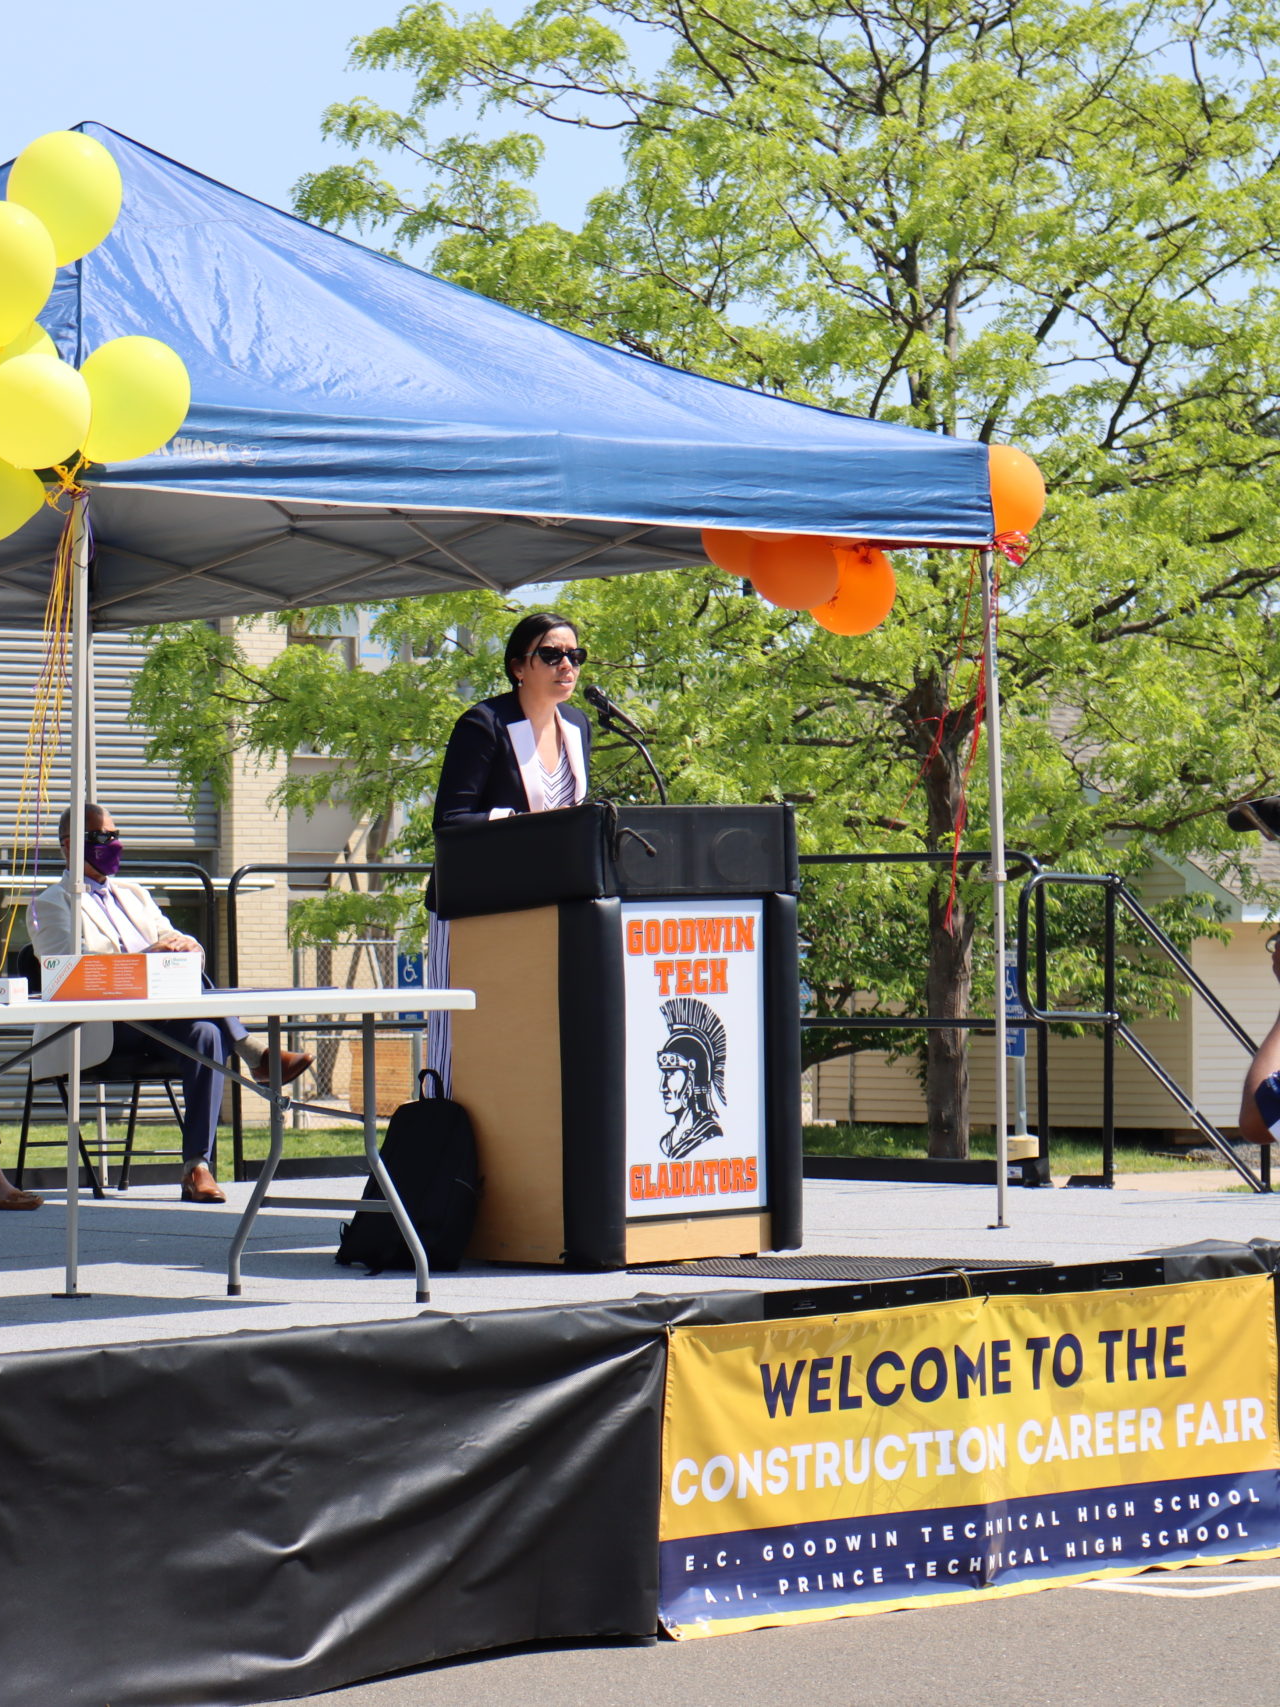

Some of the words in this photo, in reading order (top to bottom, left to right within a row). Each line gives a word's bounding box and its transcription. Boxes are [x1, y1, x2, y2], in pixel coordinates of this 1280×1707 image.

[626, 915, 756, 956] GOODWIN
[654, 958, 729, 996] TECH
[629, 1156, 758, 1201] GLADIATORS
[759, 1339, 1012, 1419] WELCOME
[1025, 1333, 1083, 1390] TO
[1098, 1325, 1187, 1384] THE
[670, 1421, 1008, 1507] CONSTRUCTION
[1016, 1406, 1166, 1466] CAREER
[1175, 1396, 1268, 1449] FAIR
[685, 1550, 741, 1572] E.C.
[762, 1530, 898, 1562] GOODWIN
[921, 1510, 1060, 1543] TECHNICAL
[1077, 1501, 1135, 1523] HIGH
[1154, 1488, 1260, 1514] SCHOOL
[703, 1584, 758, 1604] A.I.
[778, 1566, 884, 1595] PRINCE
[905, 1546, 1050, 1579] TECHNICAL
[1066, 1536, 1122, 1559] HIGH
[1141, 1522, 1249, 1549] SCHOOL
